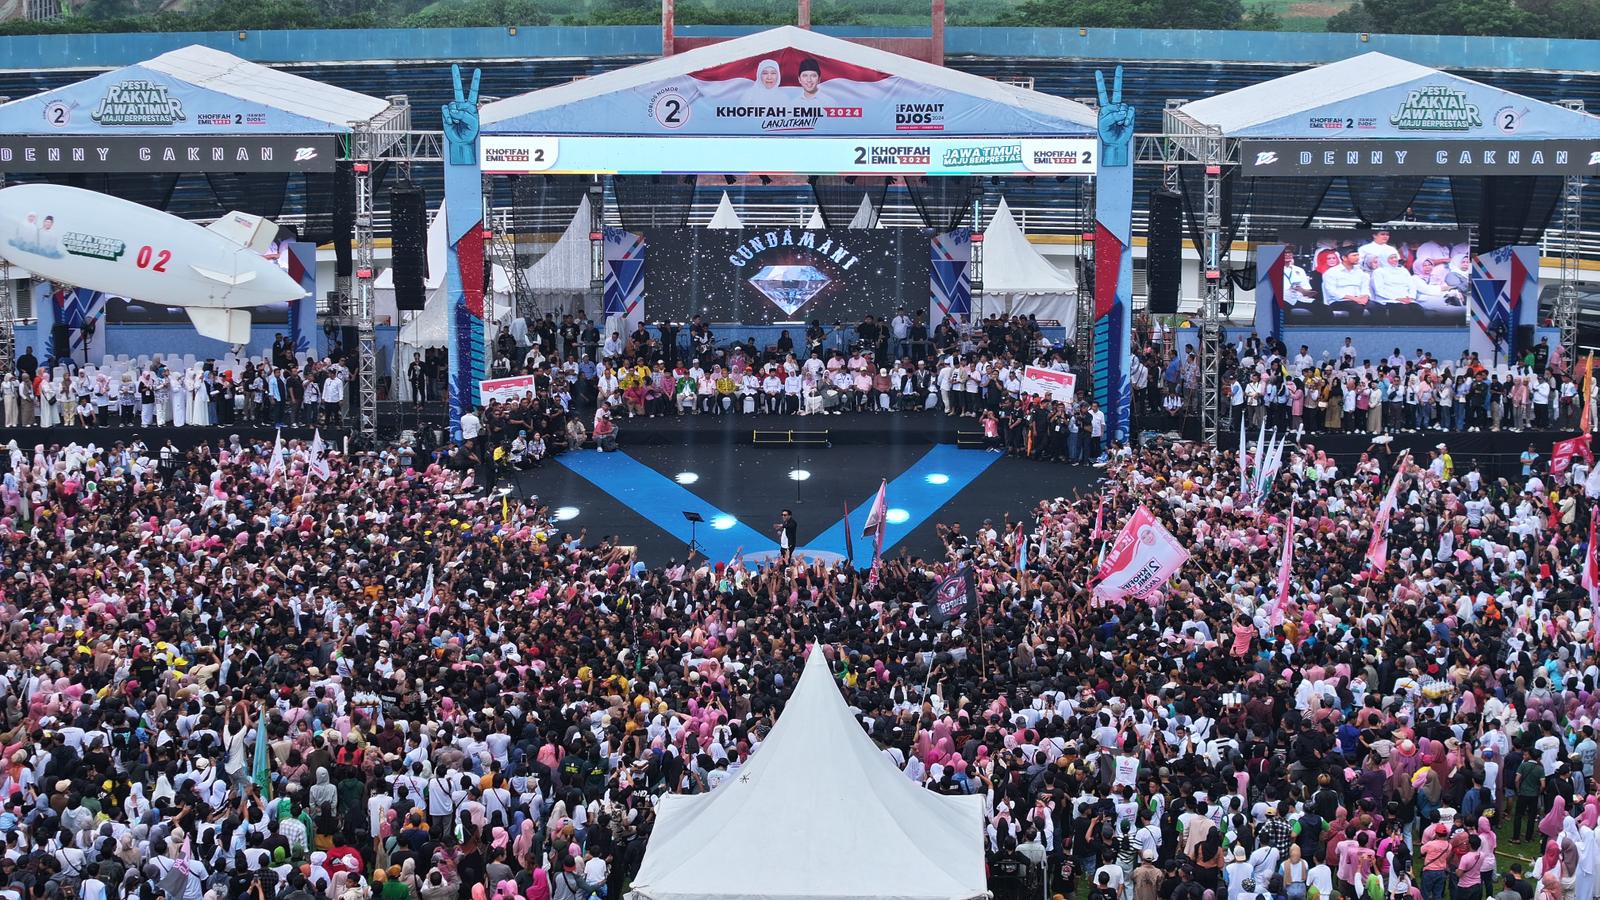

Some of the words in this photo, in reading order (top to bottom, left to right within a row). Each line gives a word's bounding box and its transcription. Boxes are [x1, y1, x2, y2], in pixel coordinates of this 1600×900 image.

[121, 82, 155, 90] PESTA
[1420, 86, 1454, 96] PESTA
[107, 86, 168, 104] RAKYAT
[1406, 92, 1466, 109] RAKYAT
[92, 98, 137, 118] JAWA
[136, 98, 185, 118] TIMUR
[665, 100, 680, 122] 2
[716, 106, 824, 118] KHOFIFAH-EMIL
[830, 108, 862, 116] 2024
[900, 104, 944, 112] FAWAIT
[1391, 104, 1434, 122] JAWA
[1432, 104, 1481, 123] TIMUR
[54, 108, 64, 123] 2
[124, 114, 172, 122] BERPRESTASI
[235, 114, 242, 124] 2
[896, 113, 932, 124] DJOS
[1504, 114, 1514, 130] 2
[1346, 118, 1354, 128] 2
[1422, 120, 1469, 128] BERPRESTASI
[1, 148, 110, 162] DENNY
[140, 147, 273, 162] CAKNAN
[534, 149, 544, 162] 2
[854, 146, 867, 164] 2
[872, 146, 930, 156] KHOFIFAH
[942, 148, 982, 160] JAWA
[982, 145, 1022, 156] TIMUR
[1082, 151, 1092, 164] 2
[872, 156, 897, 164] EMIL
[943, 157, 968, 166] MAJU
[968, 154, 1022, 165] BERPRESTAS
[1300, 151, 1408, 165] DENNY
[1436, 151, 1568, 164] CAKNAN
[729, 230, 860, 270] CUNDAMANI
[136, 246, 172, 272] 02
